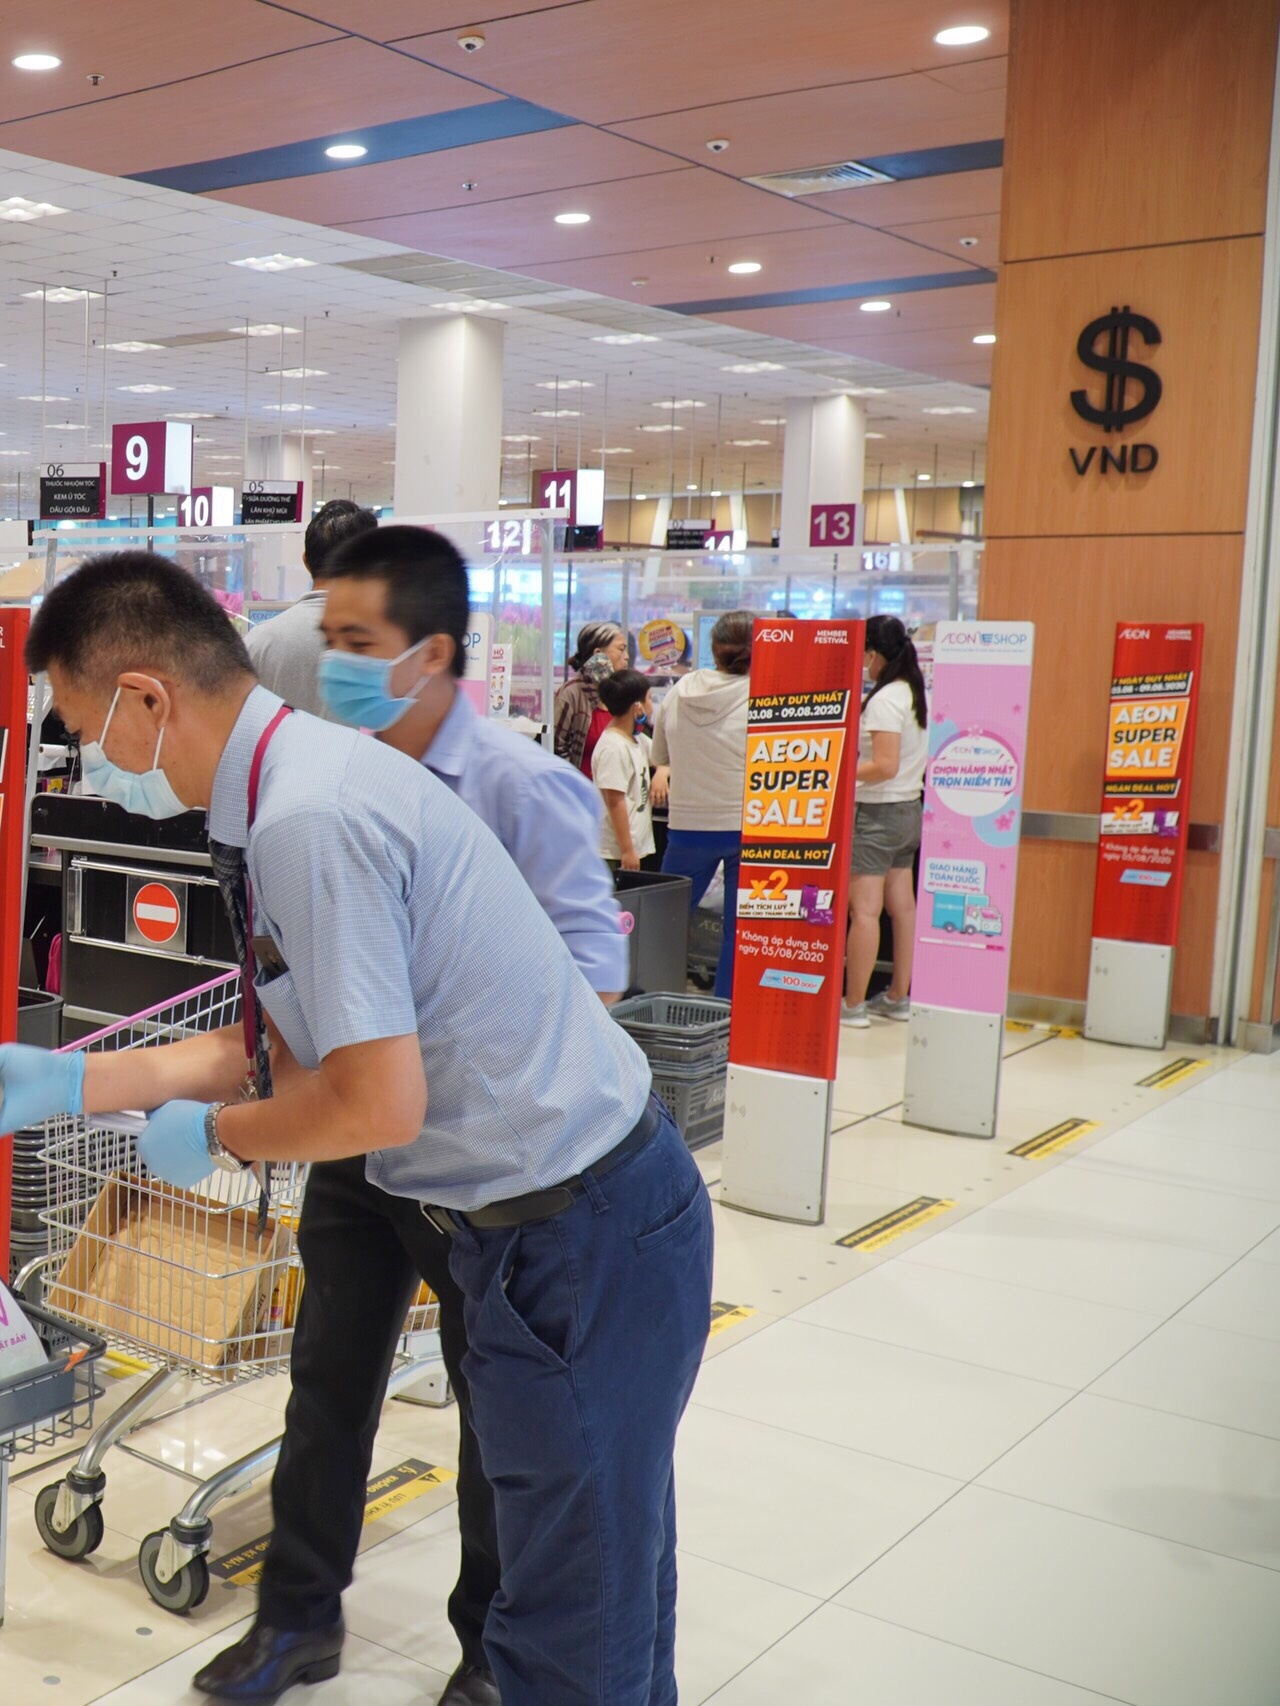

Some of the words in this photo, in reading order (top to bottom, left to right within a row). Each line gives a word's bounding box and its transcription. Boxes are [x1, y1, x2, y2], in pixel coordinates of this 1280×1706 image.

[126, 435, 149, 481] 9
[1069, 444, 1159, 475] VND
[47, 464, 64, 478] 06
[249, 481, 264, 494] 05
[545, 480, 571, 509] 11
[181, 495, 209, 526] 10
[487, 520, 521, 549] 12
[814, 511, 850, 541] 13
[704, 535, 731, 551] 14
[756, 695, 785, 707] NGÀY
[788, 693, 810, 705] DUY
[813, 690, 843, 703] NHẤT
[781, 704, 841, 718] 09.08.2020
[1115, 705, 1178, 724] AEON
[1114, 728, 1178, 744] SUPER
[751, 738, 831, 763] AEON
[1110, 748, 1173, 768] SALE
[749, 770, 831, 792] SUPER
[993, 777, 1013, 786] TIN
[745, 798, 825, 827] SALE
[1113, 799, 1145, 821] x2
[742, 848, 770, 859] NGÀN
[773, 849, 801, 859] DEAL
[804, 850, 829, 860] HOT
[749, 870, 789, 901] x2
[742, 930, 768, 945] Không
[771, 936, 783, 947] áp
[786, 936, 808, 950] dụng
[811, 939, 829, 951] cho
[739, 944, 760, 956] ngày
[761, 945, 824, 963] 05/08/2020
